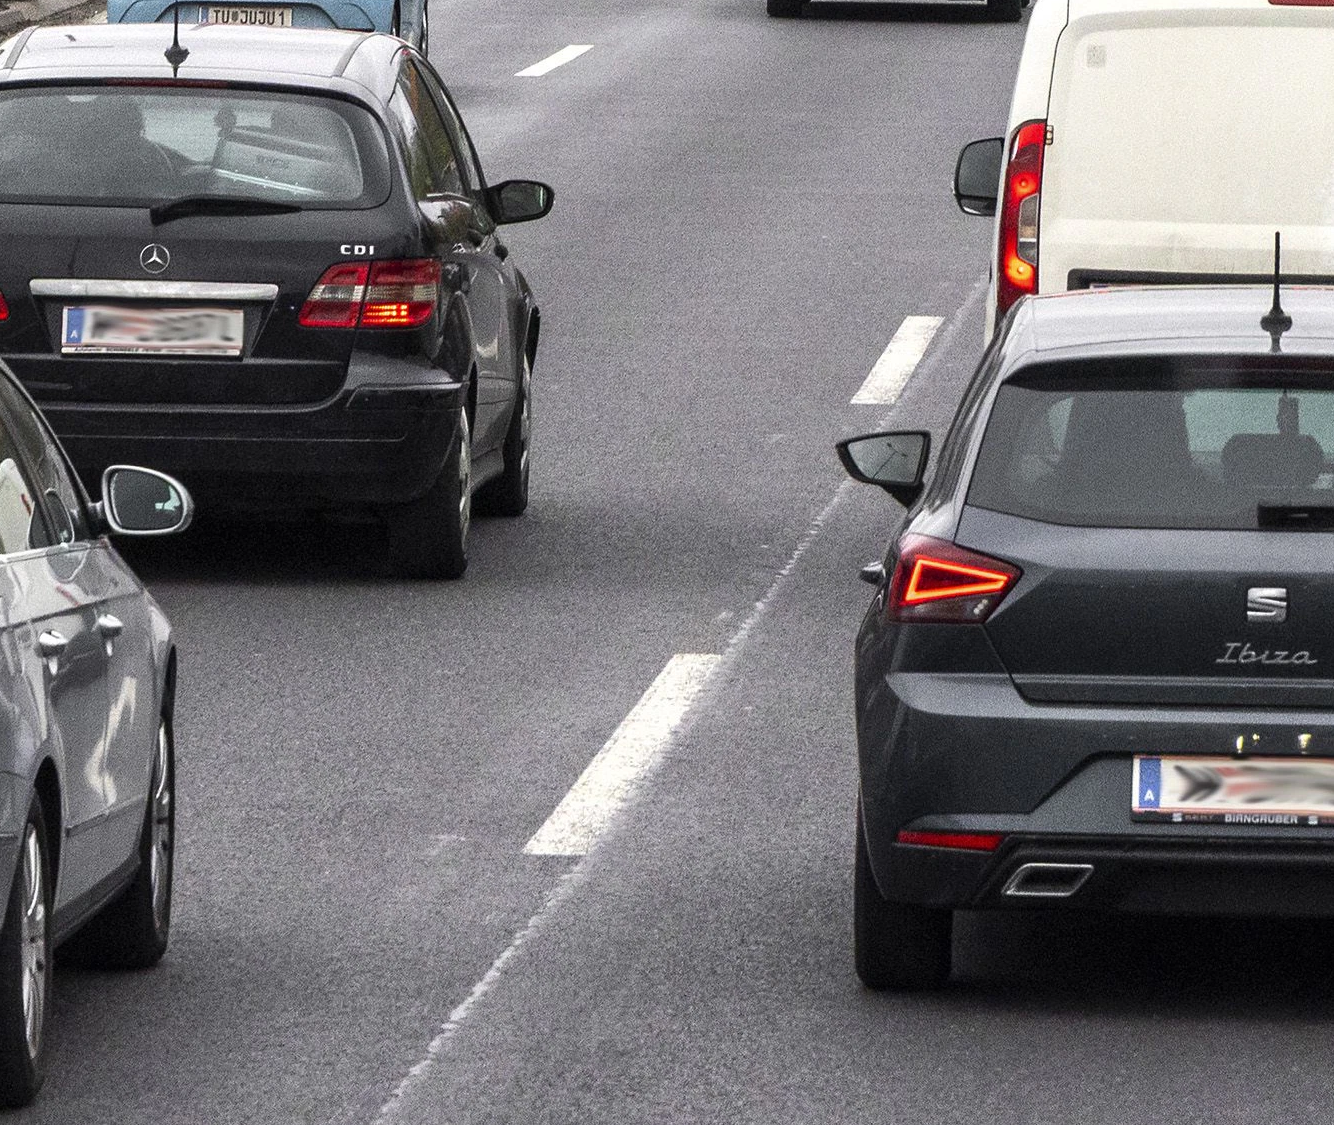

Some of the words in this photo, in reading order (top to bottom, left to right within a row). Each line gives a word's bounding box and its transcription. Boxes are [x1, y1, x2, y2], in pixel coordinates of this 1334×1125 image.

[213, 9, 230, 24] TU
[340, 244, 375, 256] CDI
[70, 330, 79, 339] A
[1216, 642, 1318, 665] Ibiza
[1144, 789, 1155, 802] A
[1224, 813, 1299, 825] BIRNGRUBER
